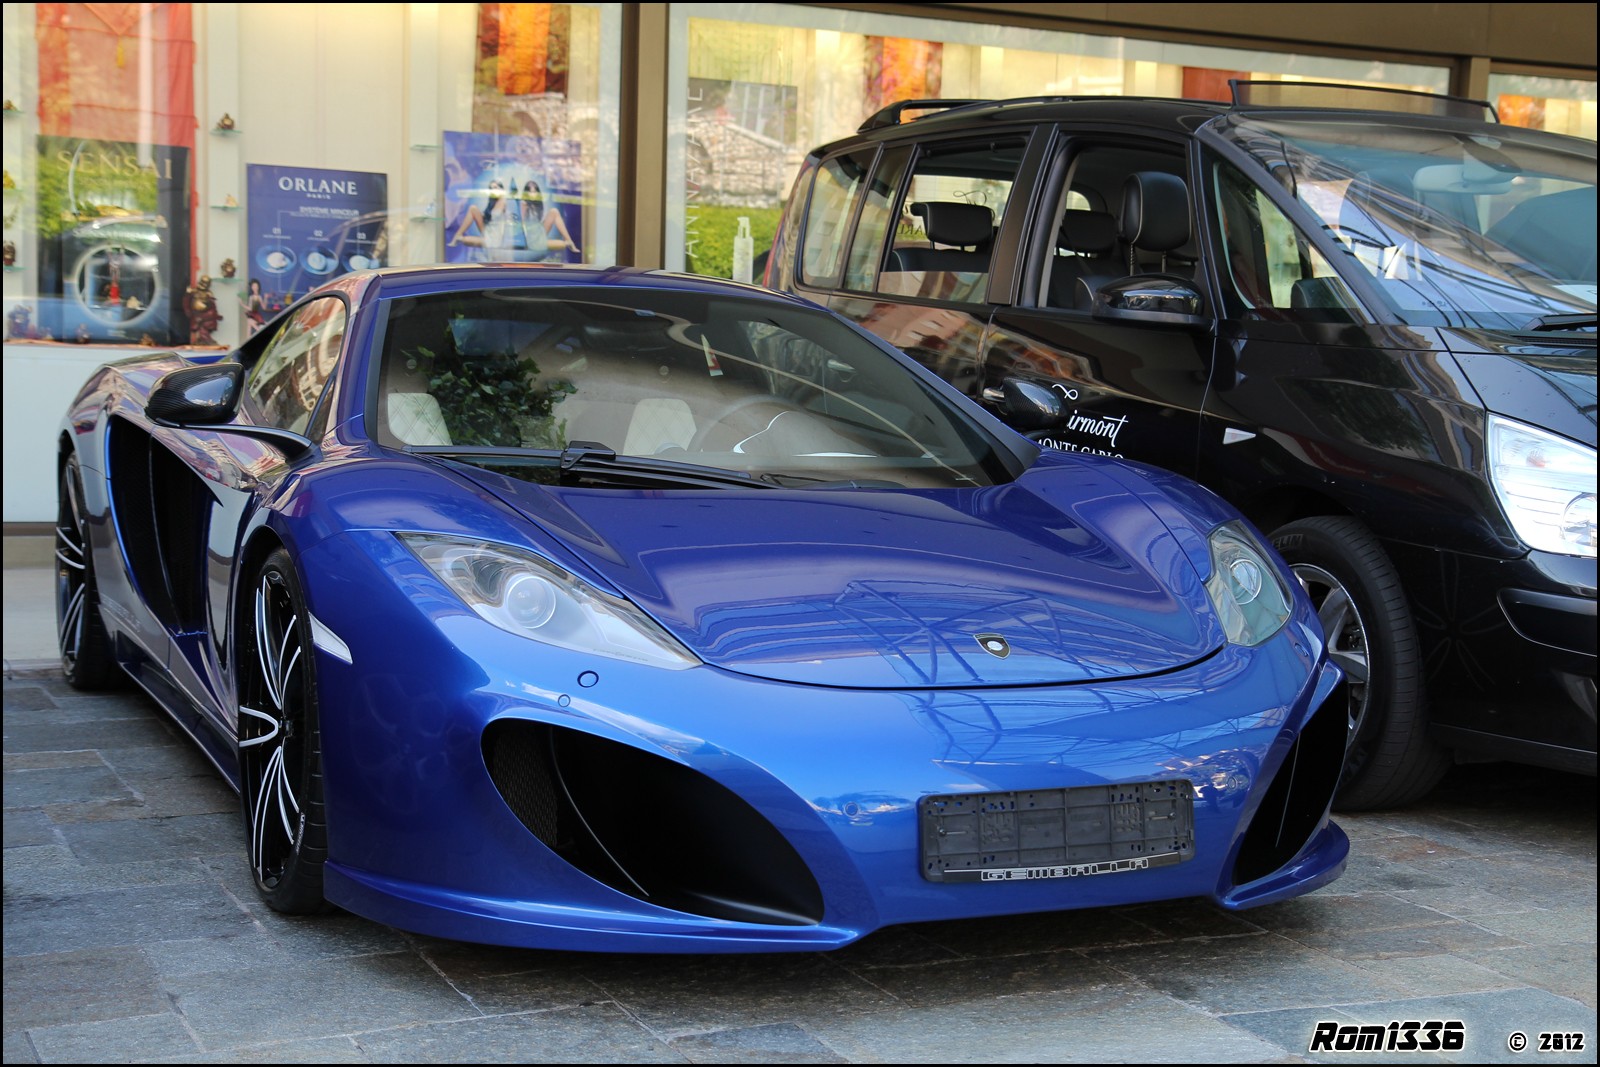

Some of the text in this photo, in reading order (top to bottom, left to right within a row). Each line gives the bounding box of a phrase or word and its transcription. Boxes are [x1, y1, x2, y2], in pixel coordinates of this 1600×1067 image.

[56, 150, 173, 180] SENSAI
[278, 176, 358, 196] ORLANE
[1067, 409, 1129, 448] irmont
[981, 858, 1149, 882] GEMBALLA
